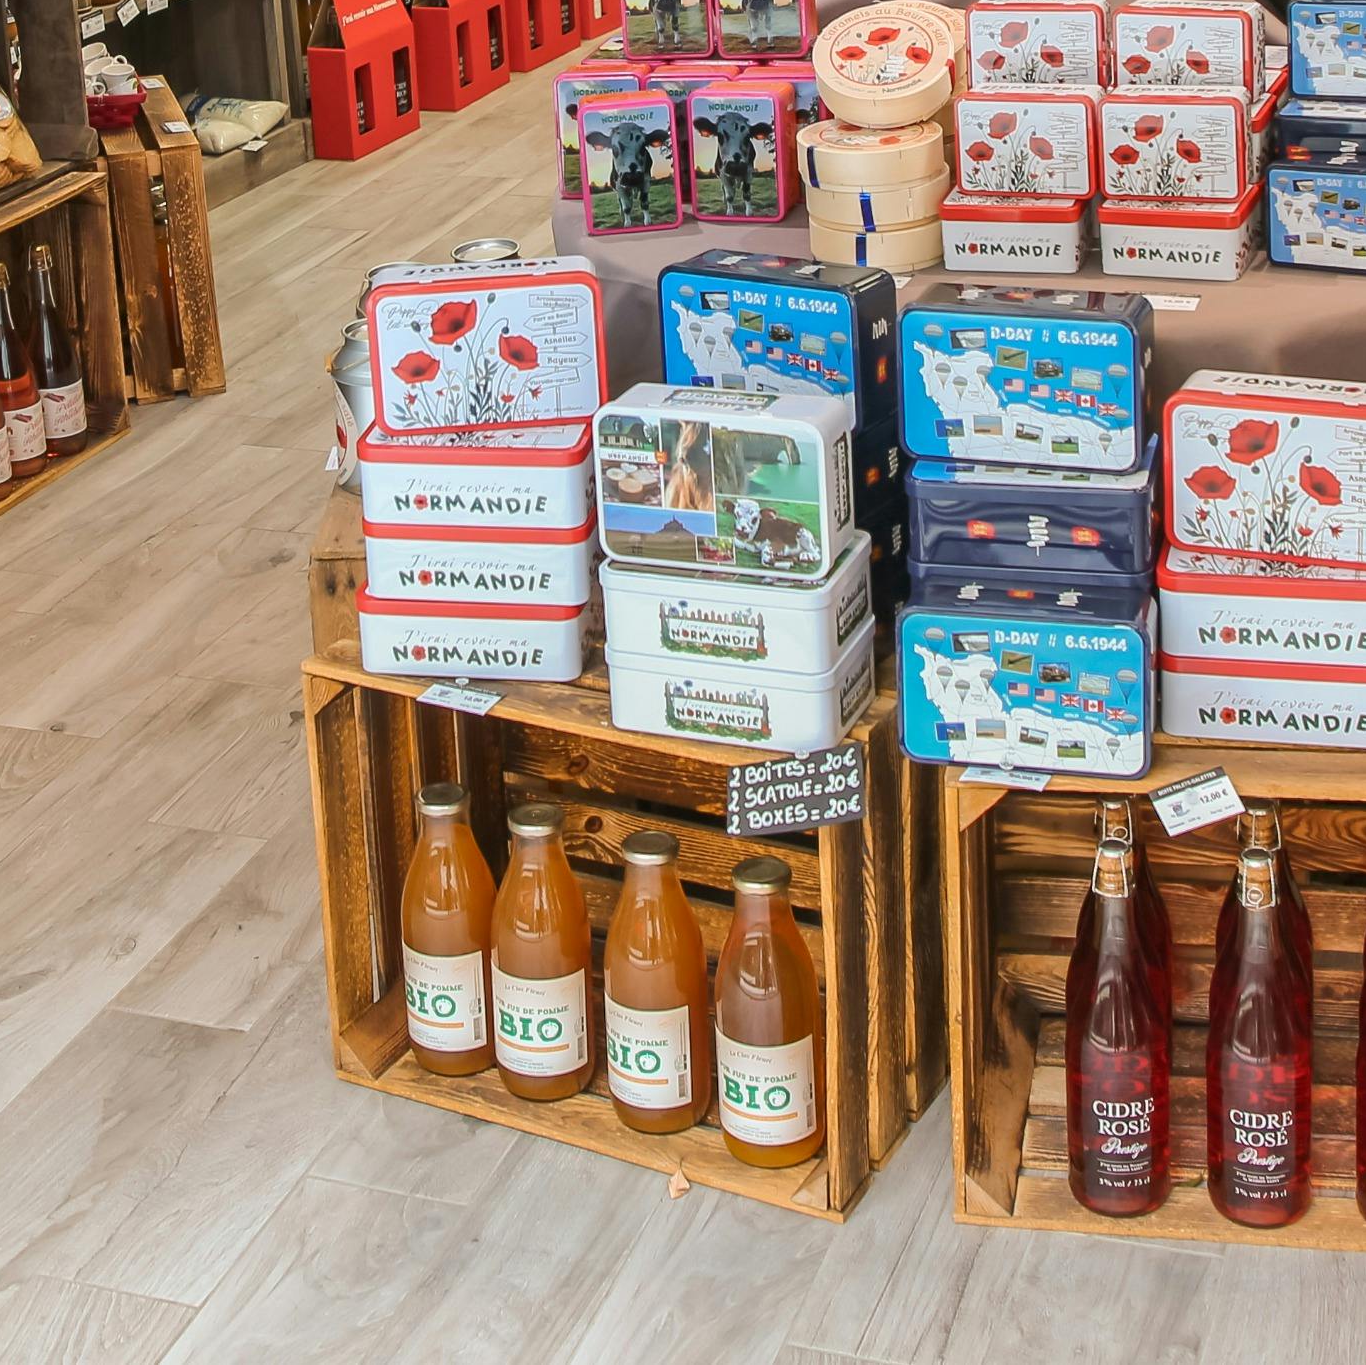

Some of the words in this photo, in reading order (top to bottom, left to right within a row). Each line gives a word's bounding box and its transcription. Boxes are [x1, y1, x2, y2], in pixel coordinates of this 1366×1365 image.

[821, 9, 871, 43] Caramels
[875, 7, 891, 16] au
[895, 8, 934, 28] Beurre
[601, 111, 654, 125] NORMANDIE
[708, 103, 759, 113] NORMANDIE
[732, 289, 768, 307] D-DAY
[787, 296, 838, 315] 6.6.1944
[543, 334, 578, 346] Asnelles
[990, 326, 1035, 342] D-DAY
[1057, 330, 1118, 347] 6.6.1944
[546, 355, 579, 367] Bayeux
[402, 478, 453, 494] J'irai
[459, 484, 506, 494] revoir
[512, 486, 533, 495] ma
[394, 494, 548, 515] NORMANDIE
[405, 554, 456, 569] J'irai
[462, 560, 510, 571] revoir
[516, 563, 538, 572] ma
[398, 570, 552, 592] NORMANDIE
[1206, 609, 1263, 626] J'irai
[1272, 616, 1324, 629] revoir
[1332, 620, 1355, 630] ma
[399, 629, 450, 645] J'irai
[455, 636, 502, 646] revoir
[509, 639, 530, 647] ma
[994, 629, 1040, 647] D-DAY
[1064, 634, 1129, 652] 6.6.1944
[392, 645, 544, 667] NORMANDIE
[1206, 690, 1263, 707] J'irai
[1271, 697, 1324, 711] revoir
[1332, 702, 1355, 713] ma
[729, 767, 741, 788] 2
[744, 759, 806, 785] BOÎTES
[819, 747, 857, 775] 20€
[728, 790, 741, 813] 2
[744, 779, 813, 809] SCATOLE
[823, 769, 861, 794] 20€
[1199, 791, 1222, 805] 12,00
[1221, 788, 1230, 798] €
[727, 815, 741, 835] 2
[746, 802, 809, 830] BOXES
[824, 794, 861, 820] 20€
[431, 984, 464, 992] POMME
[405, 982, 457, 1018] BIO
[506, 1002, 522, 1013] JUS
[523, 1007, 535, 1015] DE
[537, 1004, 570, 1016] POMME
[498, 1007, 563, 1043] BIO
[621, 1035, 633, 1044] DE
[634, 1039, 669, 1047] POMME
[606, 1035, 662, 1075] BIO
[732, 1070, 747, 1081] JUS
[749, 1074, 761, 1083] DE
[763, 1072, 798, 1084] POMME
[722, 1074, 791, 1111] BIO
[1092, 1097, 1155, 1119] CIDRE
[1229, 1108, 1293, 1130] CIDRE
[1098, 1112, 1151, 1137] ROSÉ
[1234, 1124, 1289, 1148] ROSÉ
[1100, 1137, 1148, 1159] Prestige
[1237, 1147, 1286, 1171] Prestige
[1113, 1180, 1126, 1188] vol
[1144, 1175, 1151, 1185] cl
[1249, 1190, 1262, 1200] vol
[1280, 1187, 1287, 1198] cl
